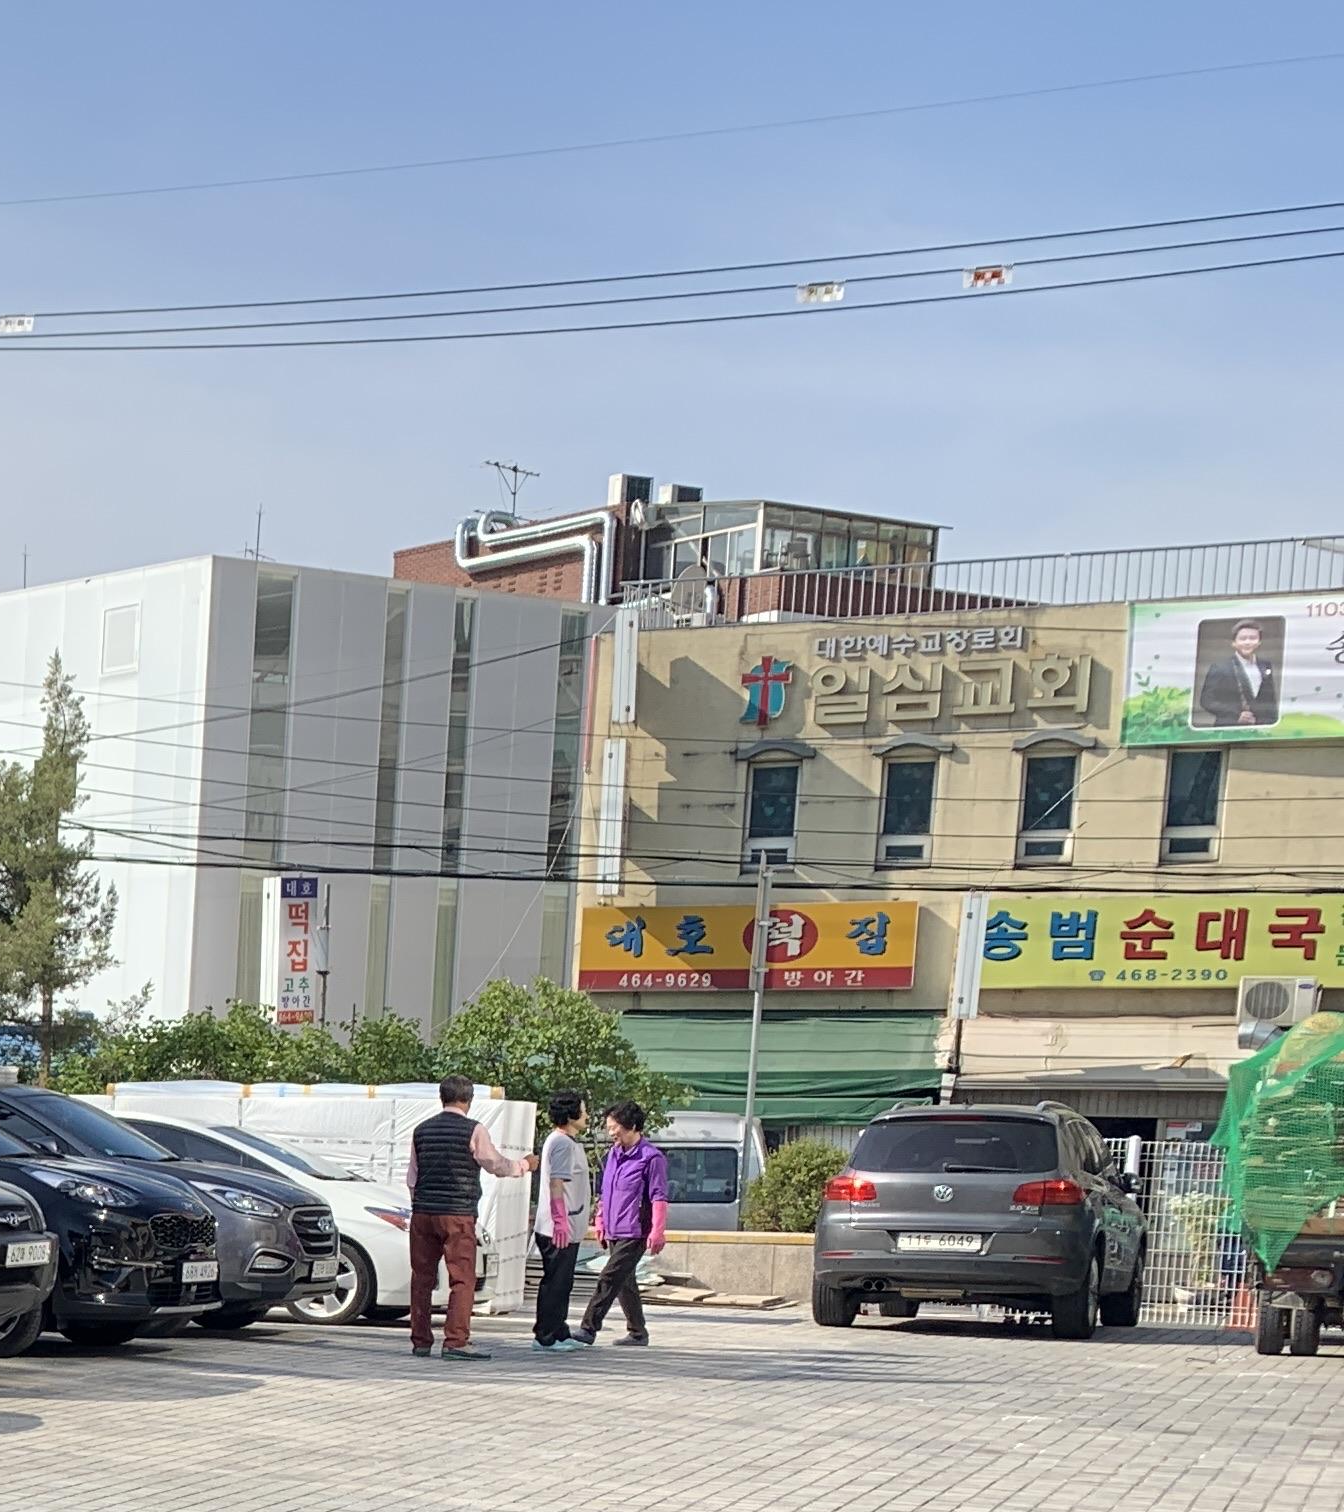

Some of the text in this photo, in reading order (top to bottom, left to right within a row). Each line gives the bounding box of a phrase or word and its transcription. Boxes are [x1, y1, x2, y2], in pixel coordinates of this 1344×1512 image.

[815, 625, 1025, 659] 대한예수교장로회
[812, 654, 1094, 726] 일심교회
[619, 972, 713, 988] 464-9629
[1116, 968, 1228, 981] 468-2390
[939, 1234, 974, 1247] 6049
